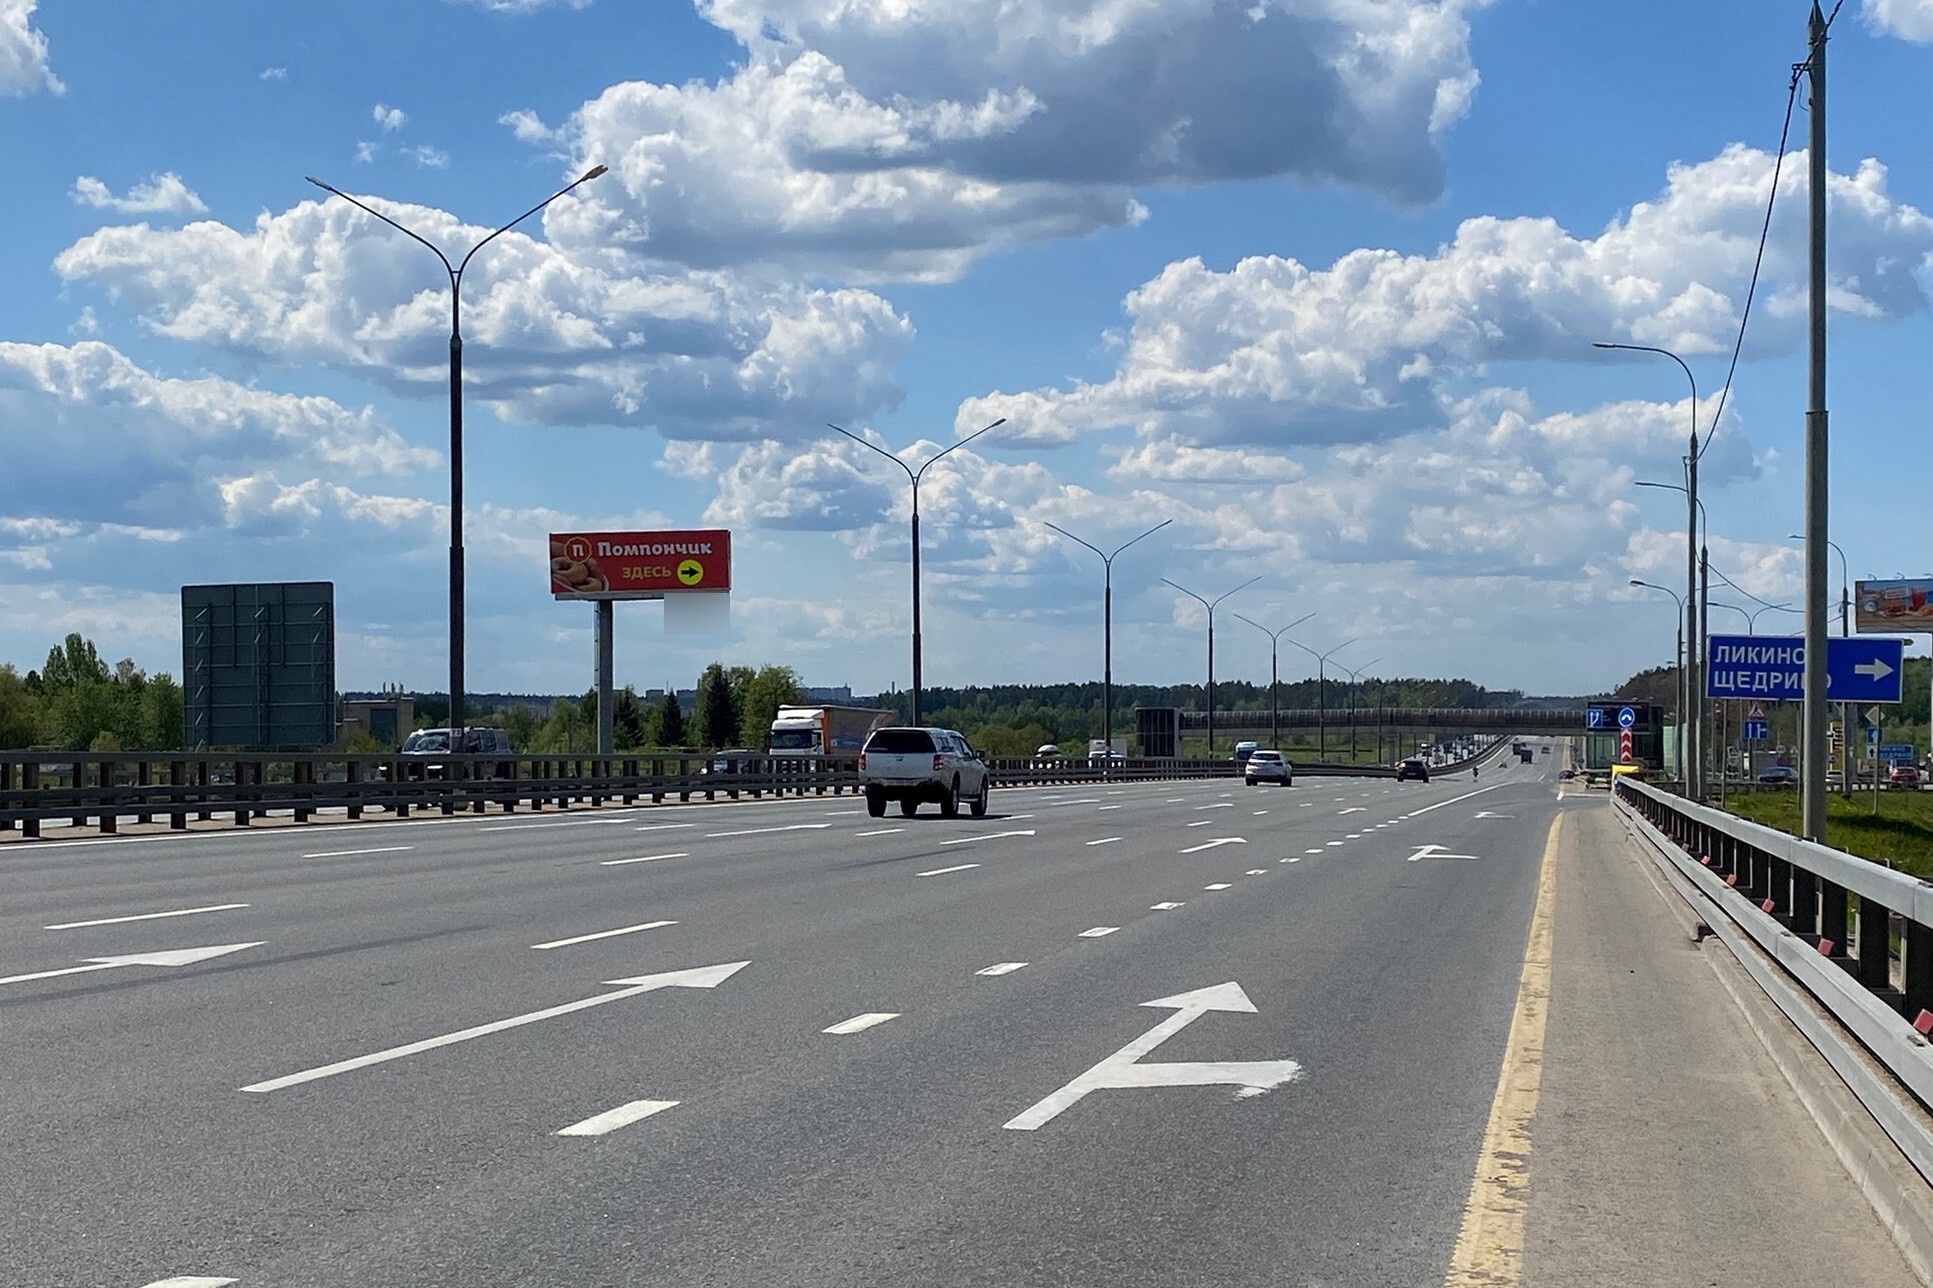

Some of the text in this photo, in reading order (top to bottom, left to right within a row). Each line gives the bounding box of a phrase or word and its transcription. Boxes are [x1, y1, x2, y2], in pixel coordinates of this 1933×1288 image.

[597, 542, 713, 557] Помпончик
[622, 566, 672, 580] ЗДЕСЬ
[1715, 645, 1805, 665] ЛИКИНО
[1714, 670, 1832, 692] ЩЕДРИ
